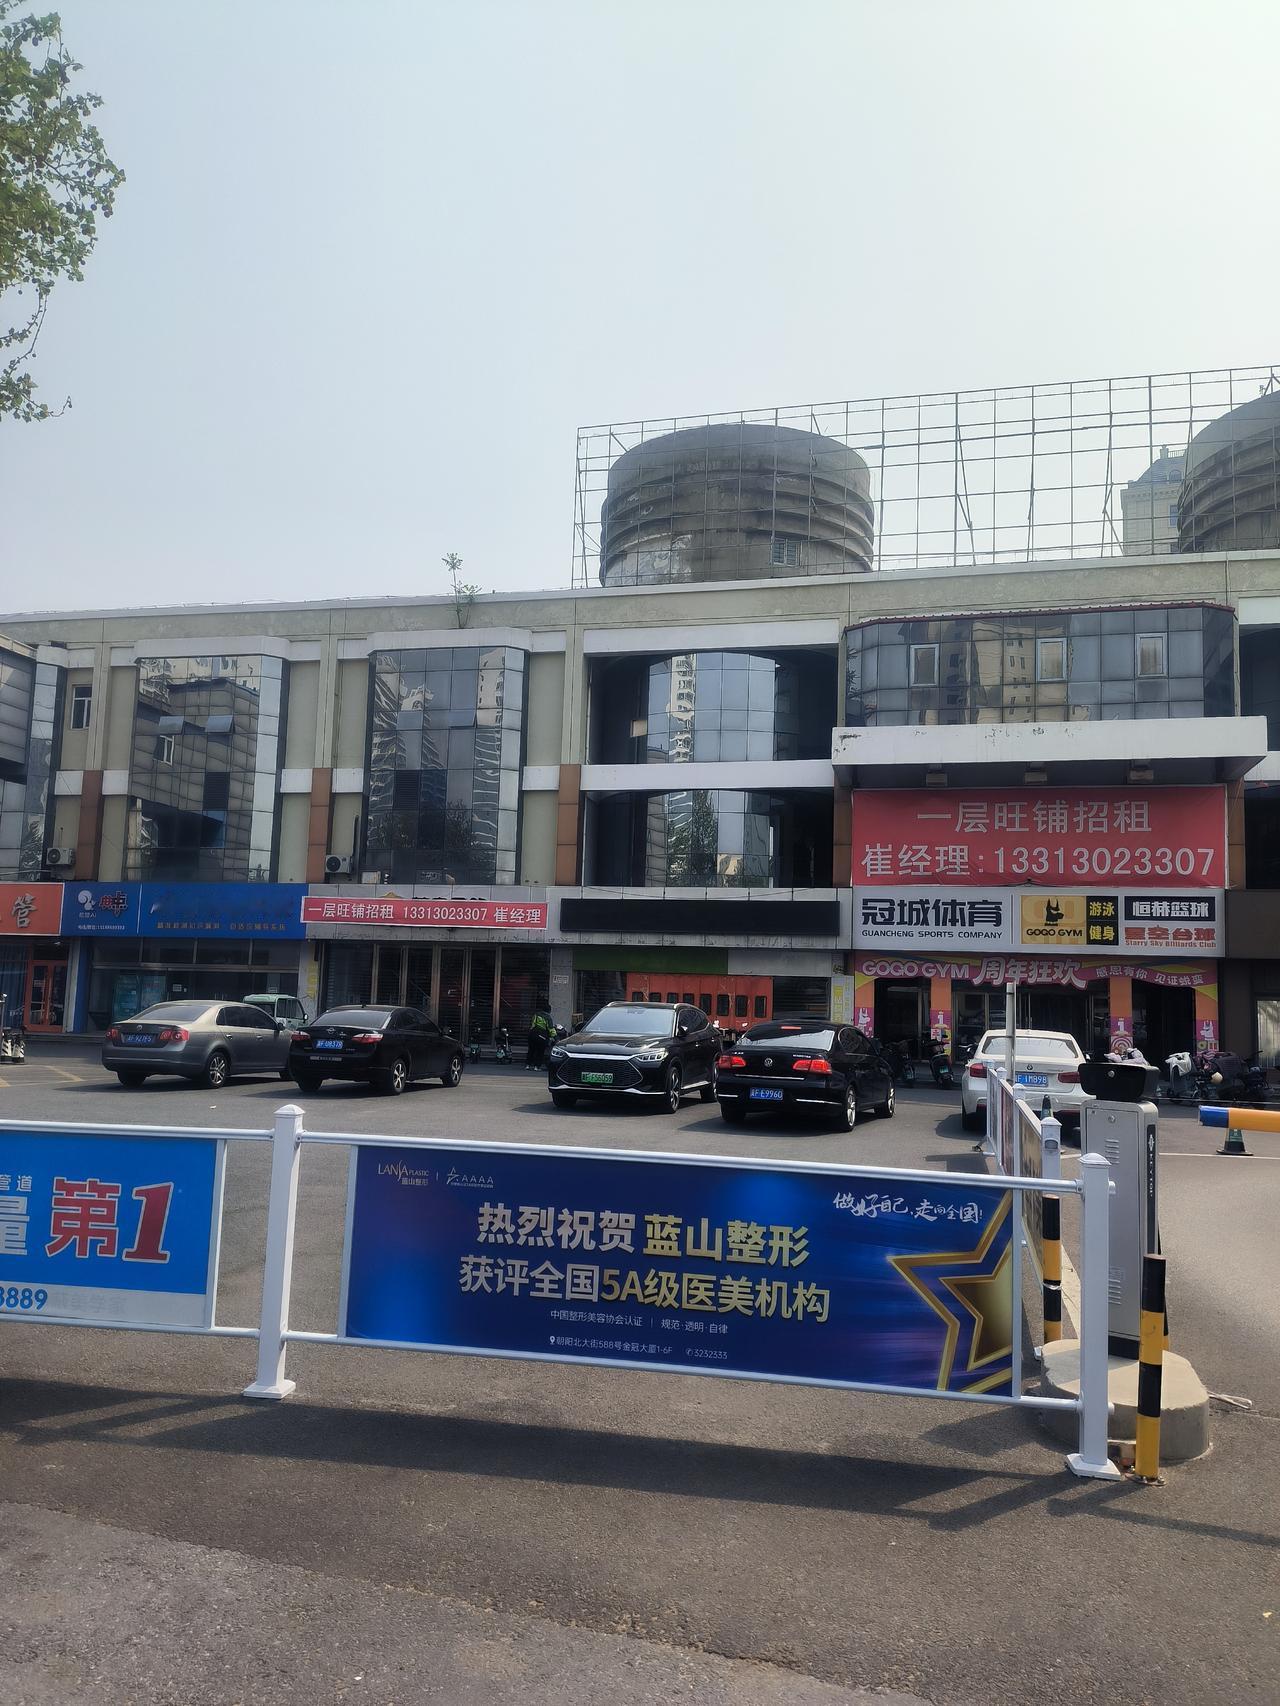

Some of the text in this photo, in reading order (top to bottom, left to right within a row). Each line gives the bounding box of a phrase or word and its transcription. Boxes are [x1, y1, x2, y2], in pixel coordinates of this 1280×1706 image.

[917, 801, 1151, 833] 一层旺铺招租
[308, 903, 541, 924] 一层旺铺招租 13313023307 崔经理
[862, 898, 1003, 927] 冠城体育
[1089, 901, 1115, 917] 游泳
[862, 929, 914, 938] GUANCHENG
[958, 931, 1002, 939] COMPANY
[1026, 928, 1082, 937] GOGO GYM
[1089, 925, 1115, 941] 健身
[862, 956, 1087, 989] GOGO GYM 周年狂欢
[477, 1201, 810, 1267] 热烈祝贺 蓝山整形
[459, 1254, 831, 1324] 获评全国5A级医美机构
[550, 1309, 643, 1327] 中国整形美容协会认证
[694, 1348, 728, 1360] 3232333
